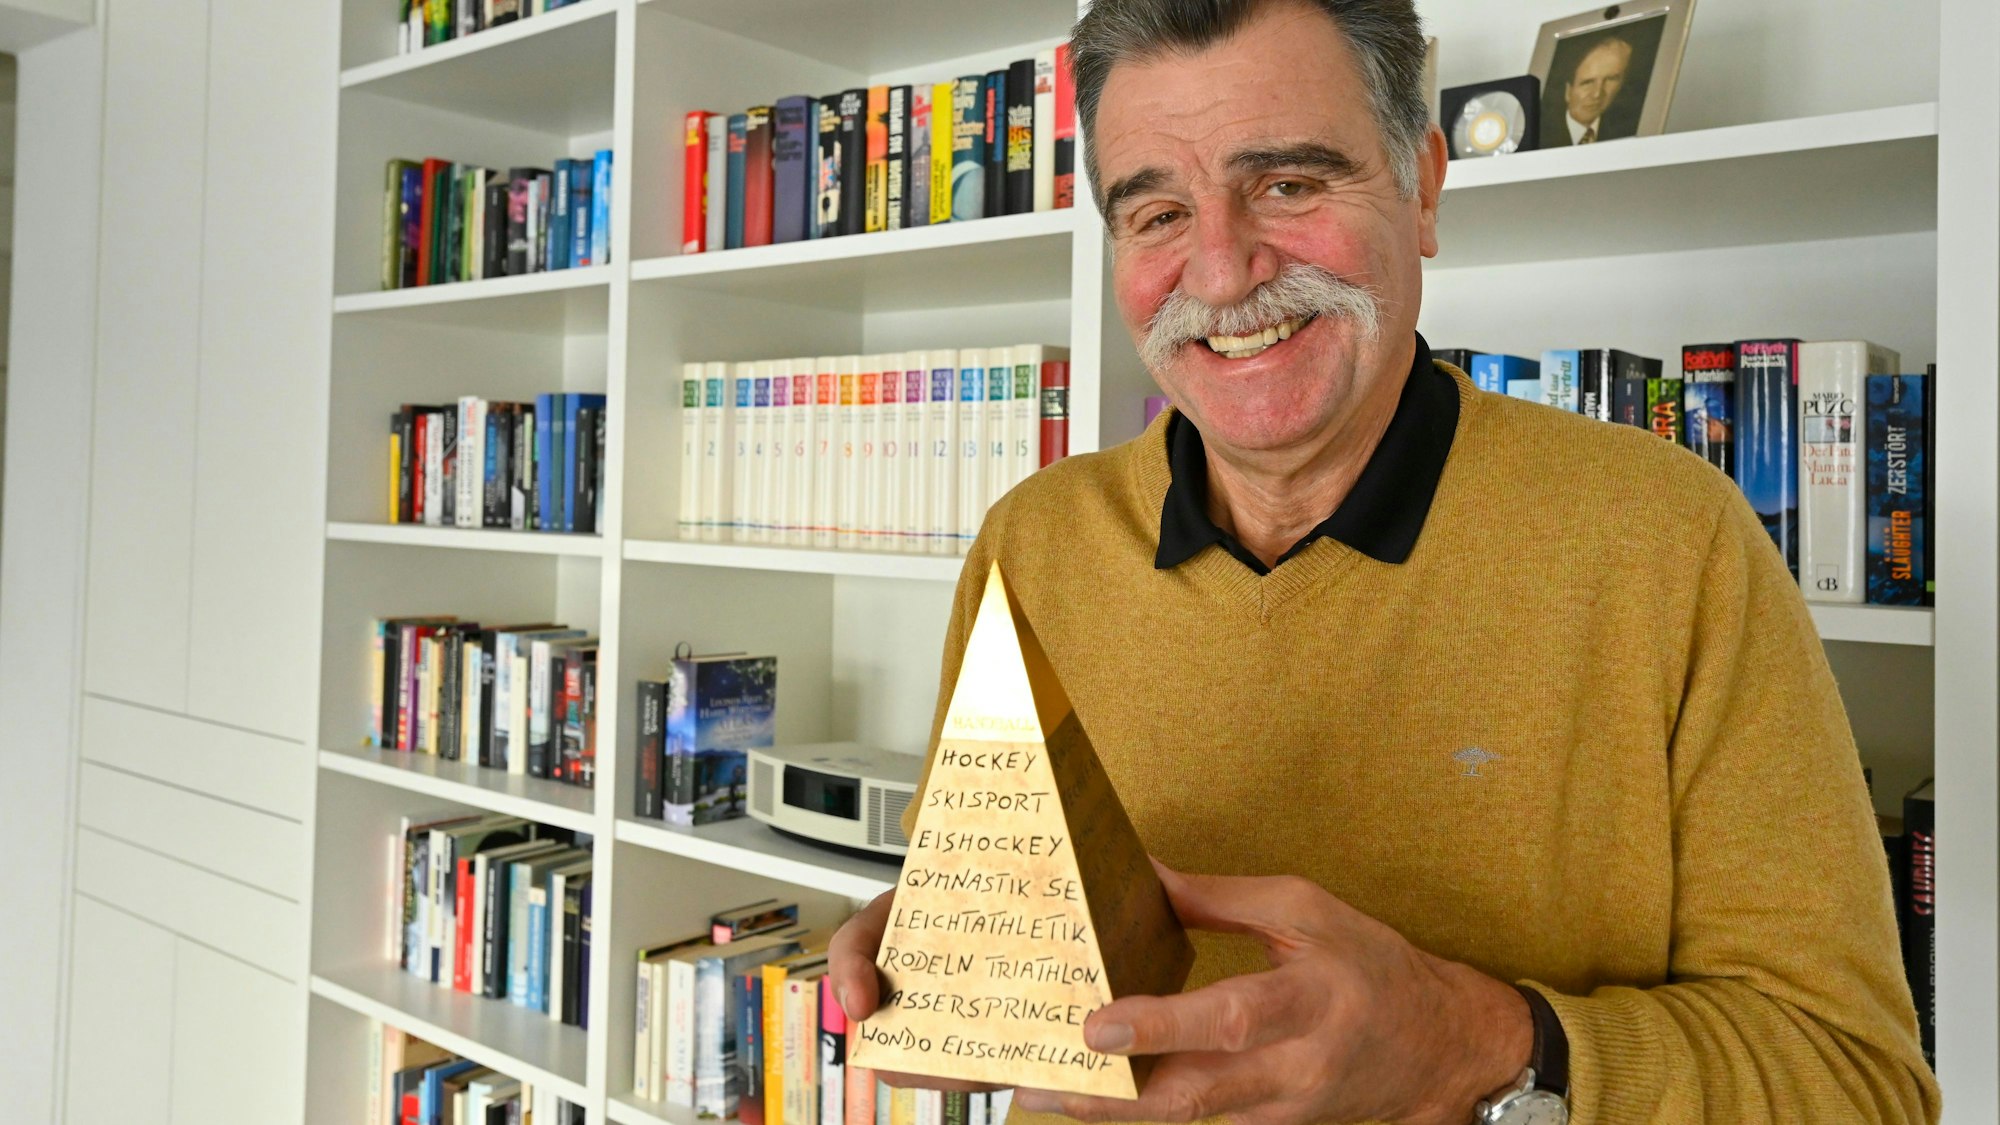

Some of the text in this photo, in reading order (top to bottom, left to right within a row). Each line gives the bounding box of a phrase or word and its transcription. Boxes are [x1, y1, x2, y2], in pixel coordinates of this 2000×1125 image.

[774, 442, 782, 458] 5
[795, 440, 804, 458] 6
[864, 441, 873, 458] 9
[883, 440, 897, 458] 10
[907, 441, 919, 458] 11
[933, 440, 947, 458] 12
[962, 440, 977, 458] 13
[991, 441, 1003, 458] 14
[1015, 439, 1028, 458] 15
[1888, 425, 1911, 580] SLAUGHTER ZERSTÖRT
[941, 749, 1037, 772] HOCKEY
[928, 789, 1050, 813] SKISPORT
[918, 830, 1063, 857] EISHOCKEY
[905, 868, 1079, 901] GYMNASTIK SE
[894, 907, 1087, 944] LEICHTATHLETIK
[883, 946, 1099, 986] RODELN TRIATHLON
[886, 989, 1104, 1026] ASSERSPRINGE
[861, 1021, 932, 1052] WONDO
